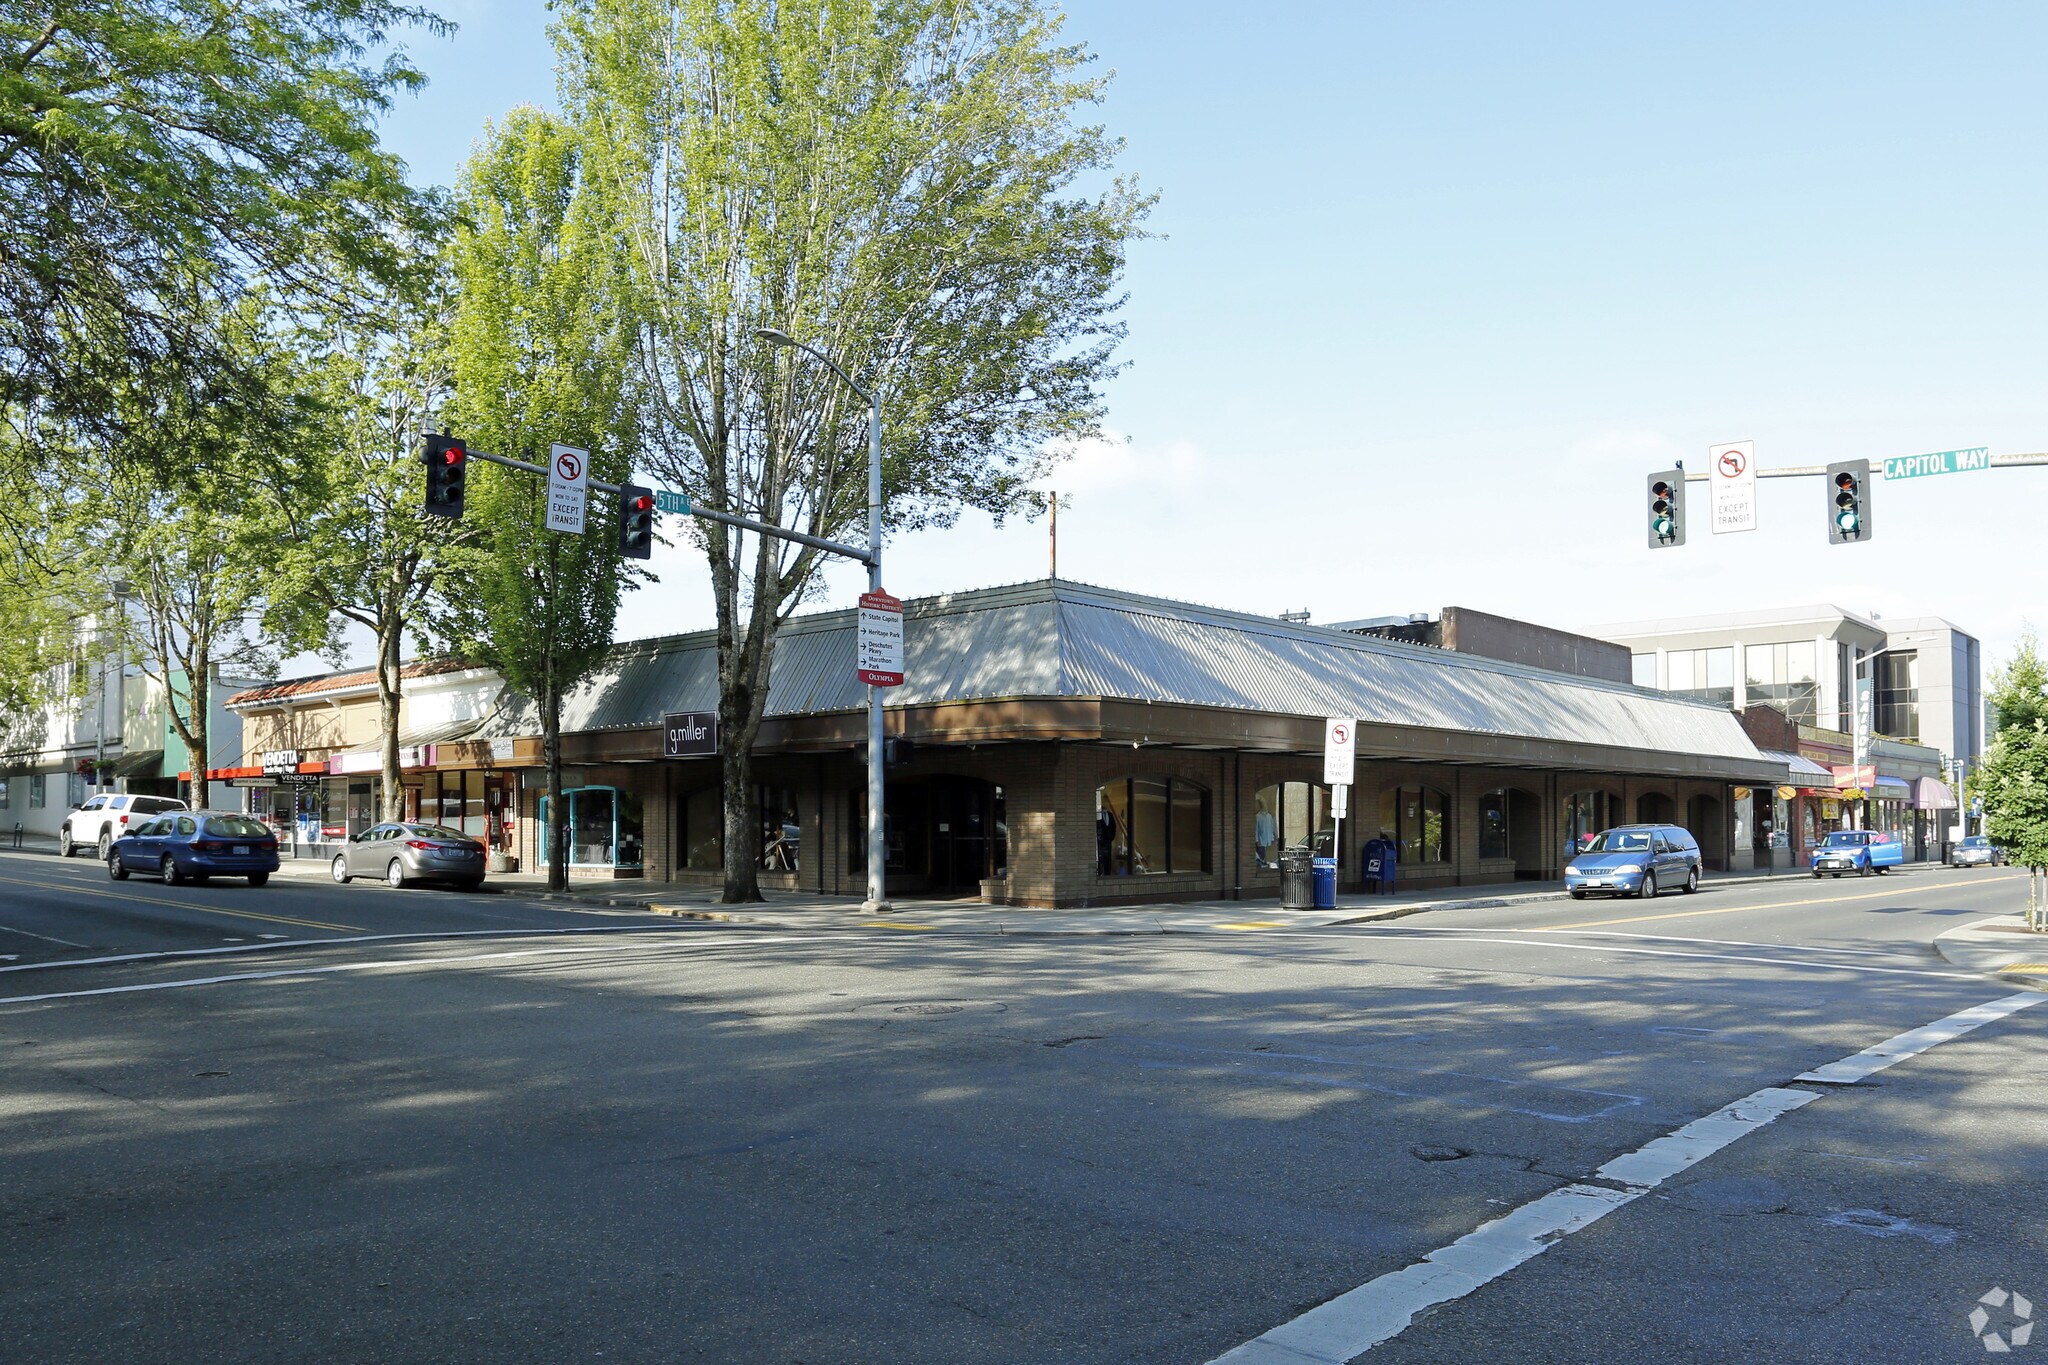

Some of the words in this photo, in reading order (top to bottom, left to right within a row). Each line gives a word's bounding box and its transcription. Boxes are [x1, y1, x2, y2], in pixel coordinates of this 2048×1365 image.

[1884, 454, 1949, 478] CAPITOL
[1955, 448, 1988, 470] WAY
[658, 493, 678, 510] 5TH
[552, 503, 579, 515] EXCEPT
[1719, 502, 1748, 514] EXCEPT
[552, 514, 579, 526] TRANSIT
[1718, 514, 1750, 524] TRANSIT
[868, 613, 881, 621] State
[882, 615, 899, 623] Capitol
[868, 628, 889, 638] Heritage
[868, 641, 893, 650] Deschutes
[868, 647, 884, 656] Pkwy.
[868, 656, 892, 664] Marathon
[670, 715, 707, 754] g.miller
[262, 750, 297, 766] VENDETTA
